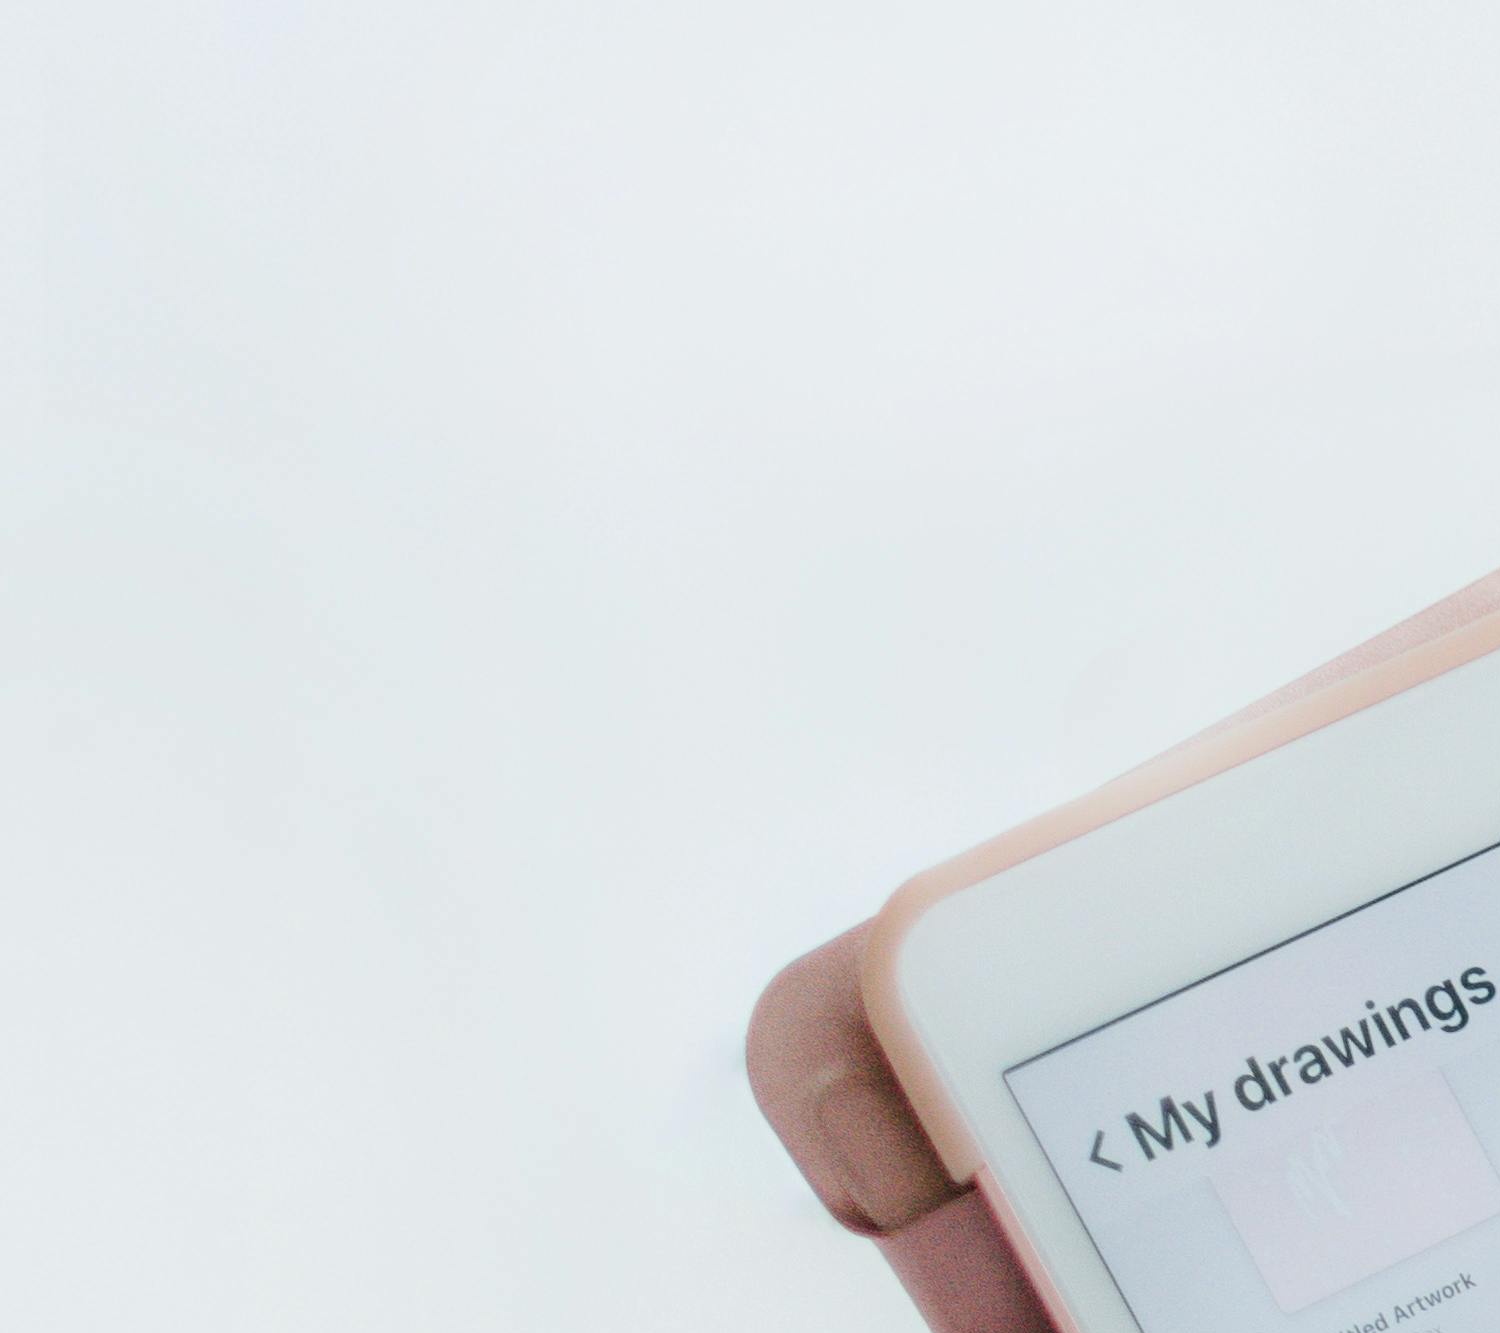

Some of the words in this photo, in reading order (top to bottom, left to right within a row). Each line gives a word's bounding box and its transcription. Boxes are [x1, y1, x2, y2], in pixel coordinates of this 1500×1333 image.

[1126, 1091, 1222, 1160] My
[1234, 966, 1497, 1111] drawings
[1393, 1273, 1476, 1323] Artwork
